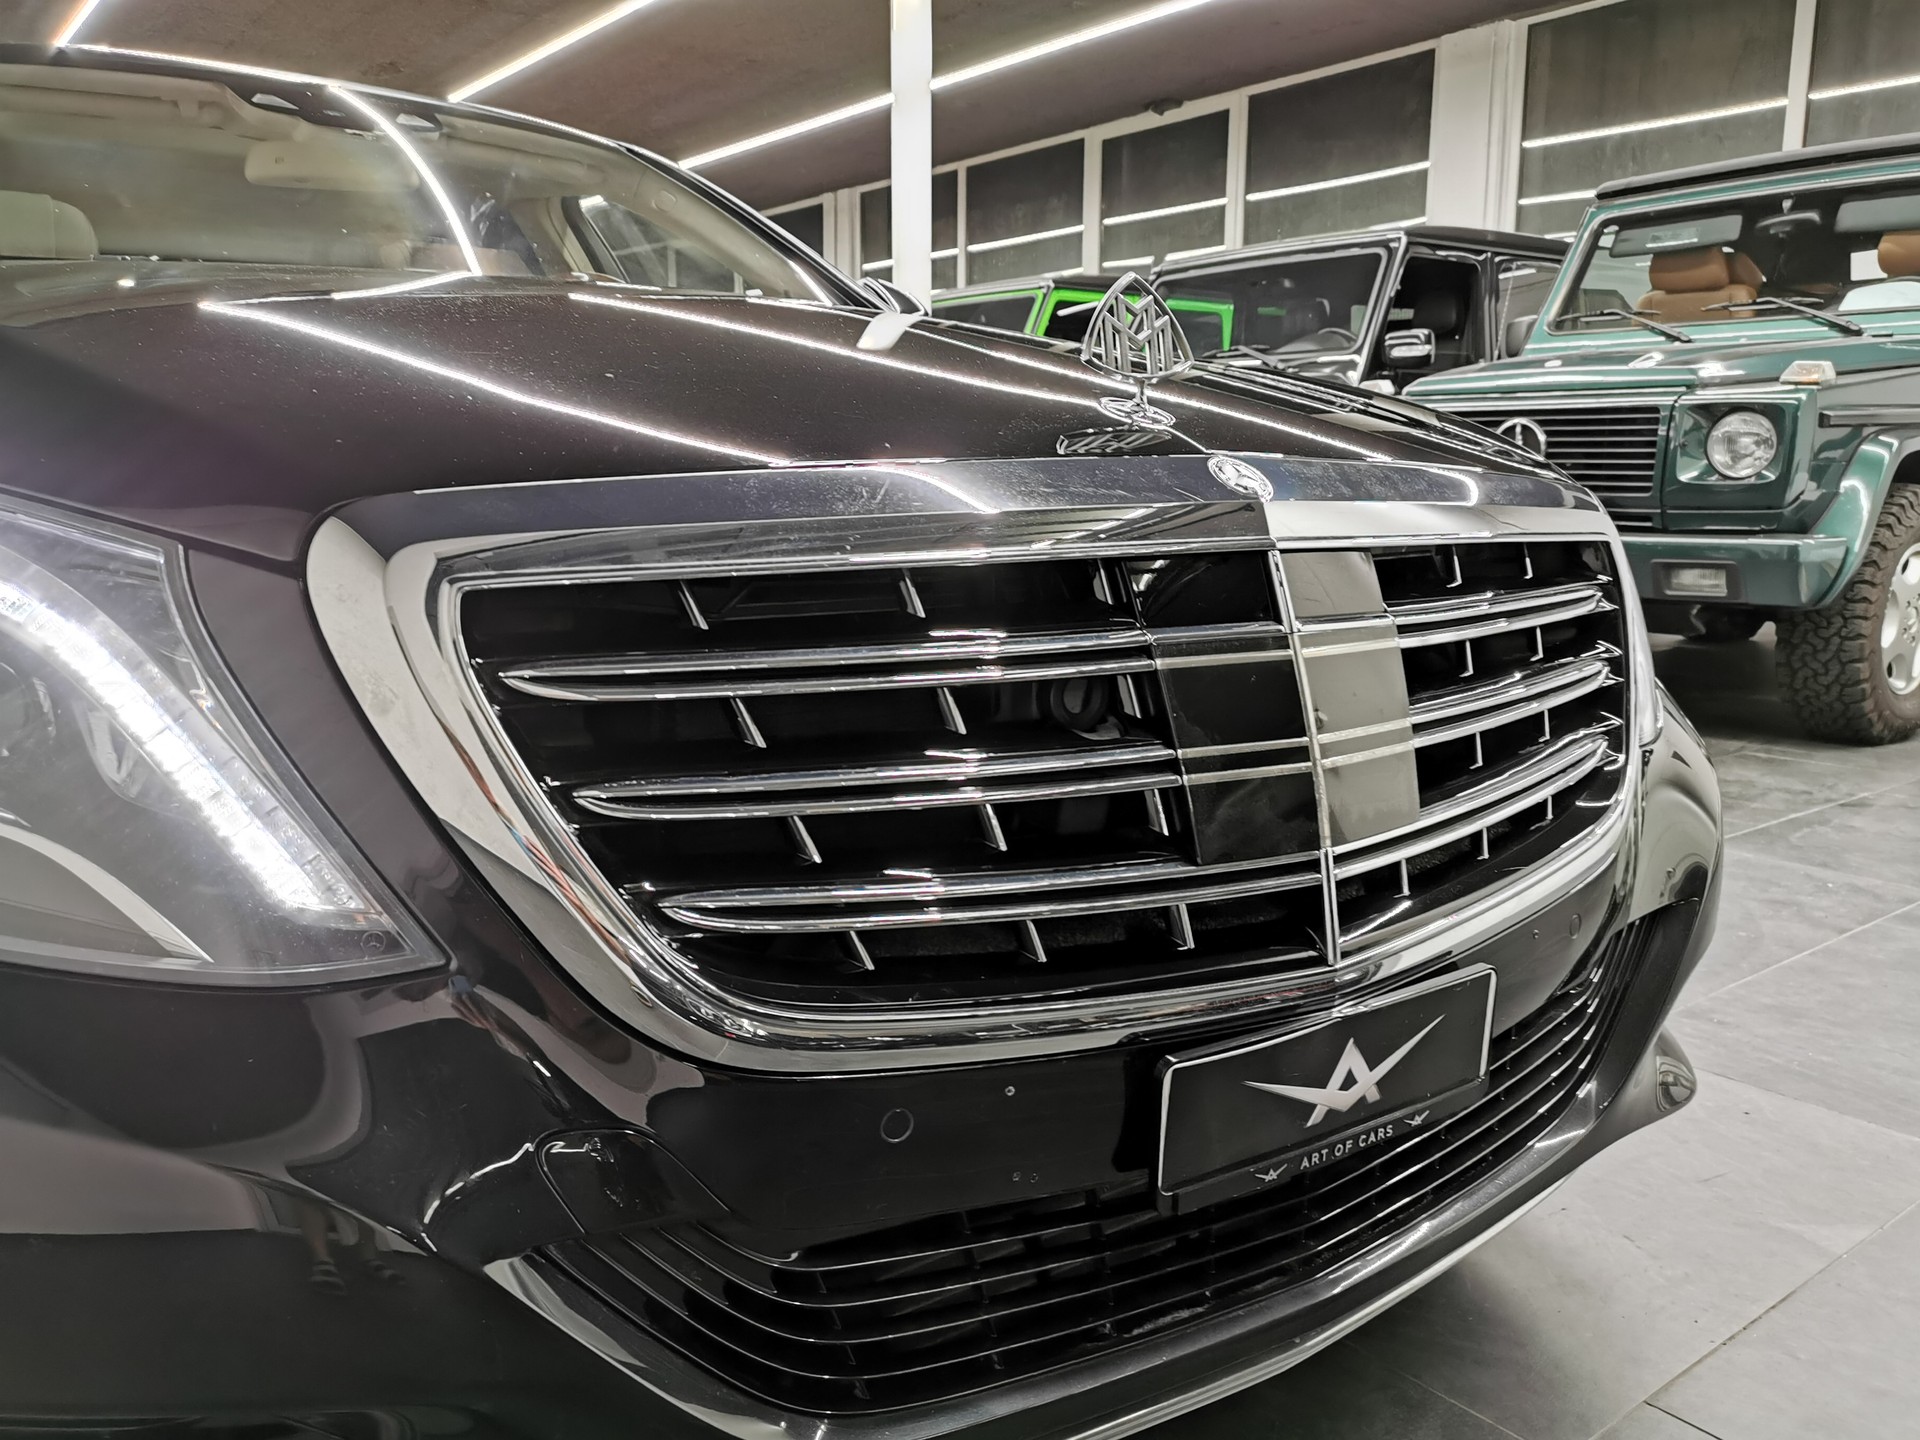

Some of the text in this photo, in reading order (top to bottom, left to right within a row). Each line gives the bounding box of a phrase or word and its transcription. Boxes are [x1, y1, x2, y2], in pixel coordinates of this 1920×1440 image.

[1300, 1125, 1393, 1170] ART OF CARS
